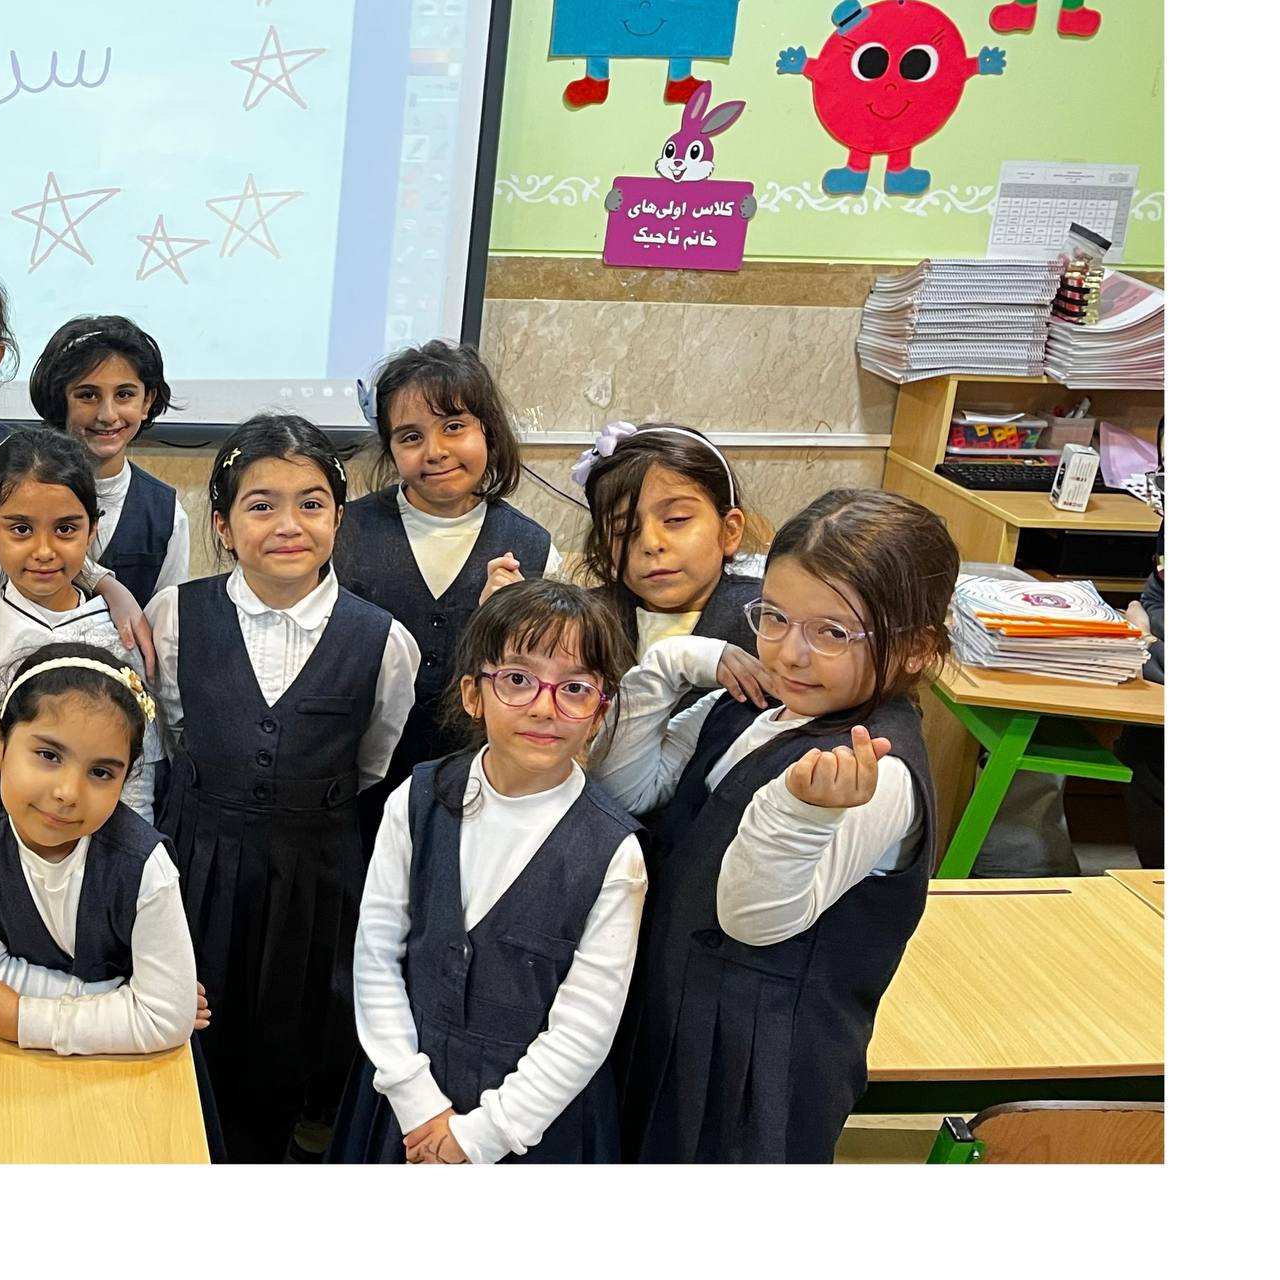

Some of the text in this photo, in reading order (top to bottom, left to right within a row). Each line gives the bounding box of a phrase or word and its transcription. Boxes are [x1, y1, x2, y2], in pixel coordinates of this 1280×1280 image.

[691, 200, 735, 219] کلاس
[633, 225, 718, 251] خانم تاجیک
